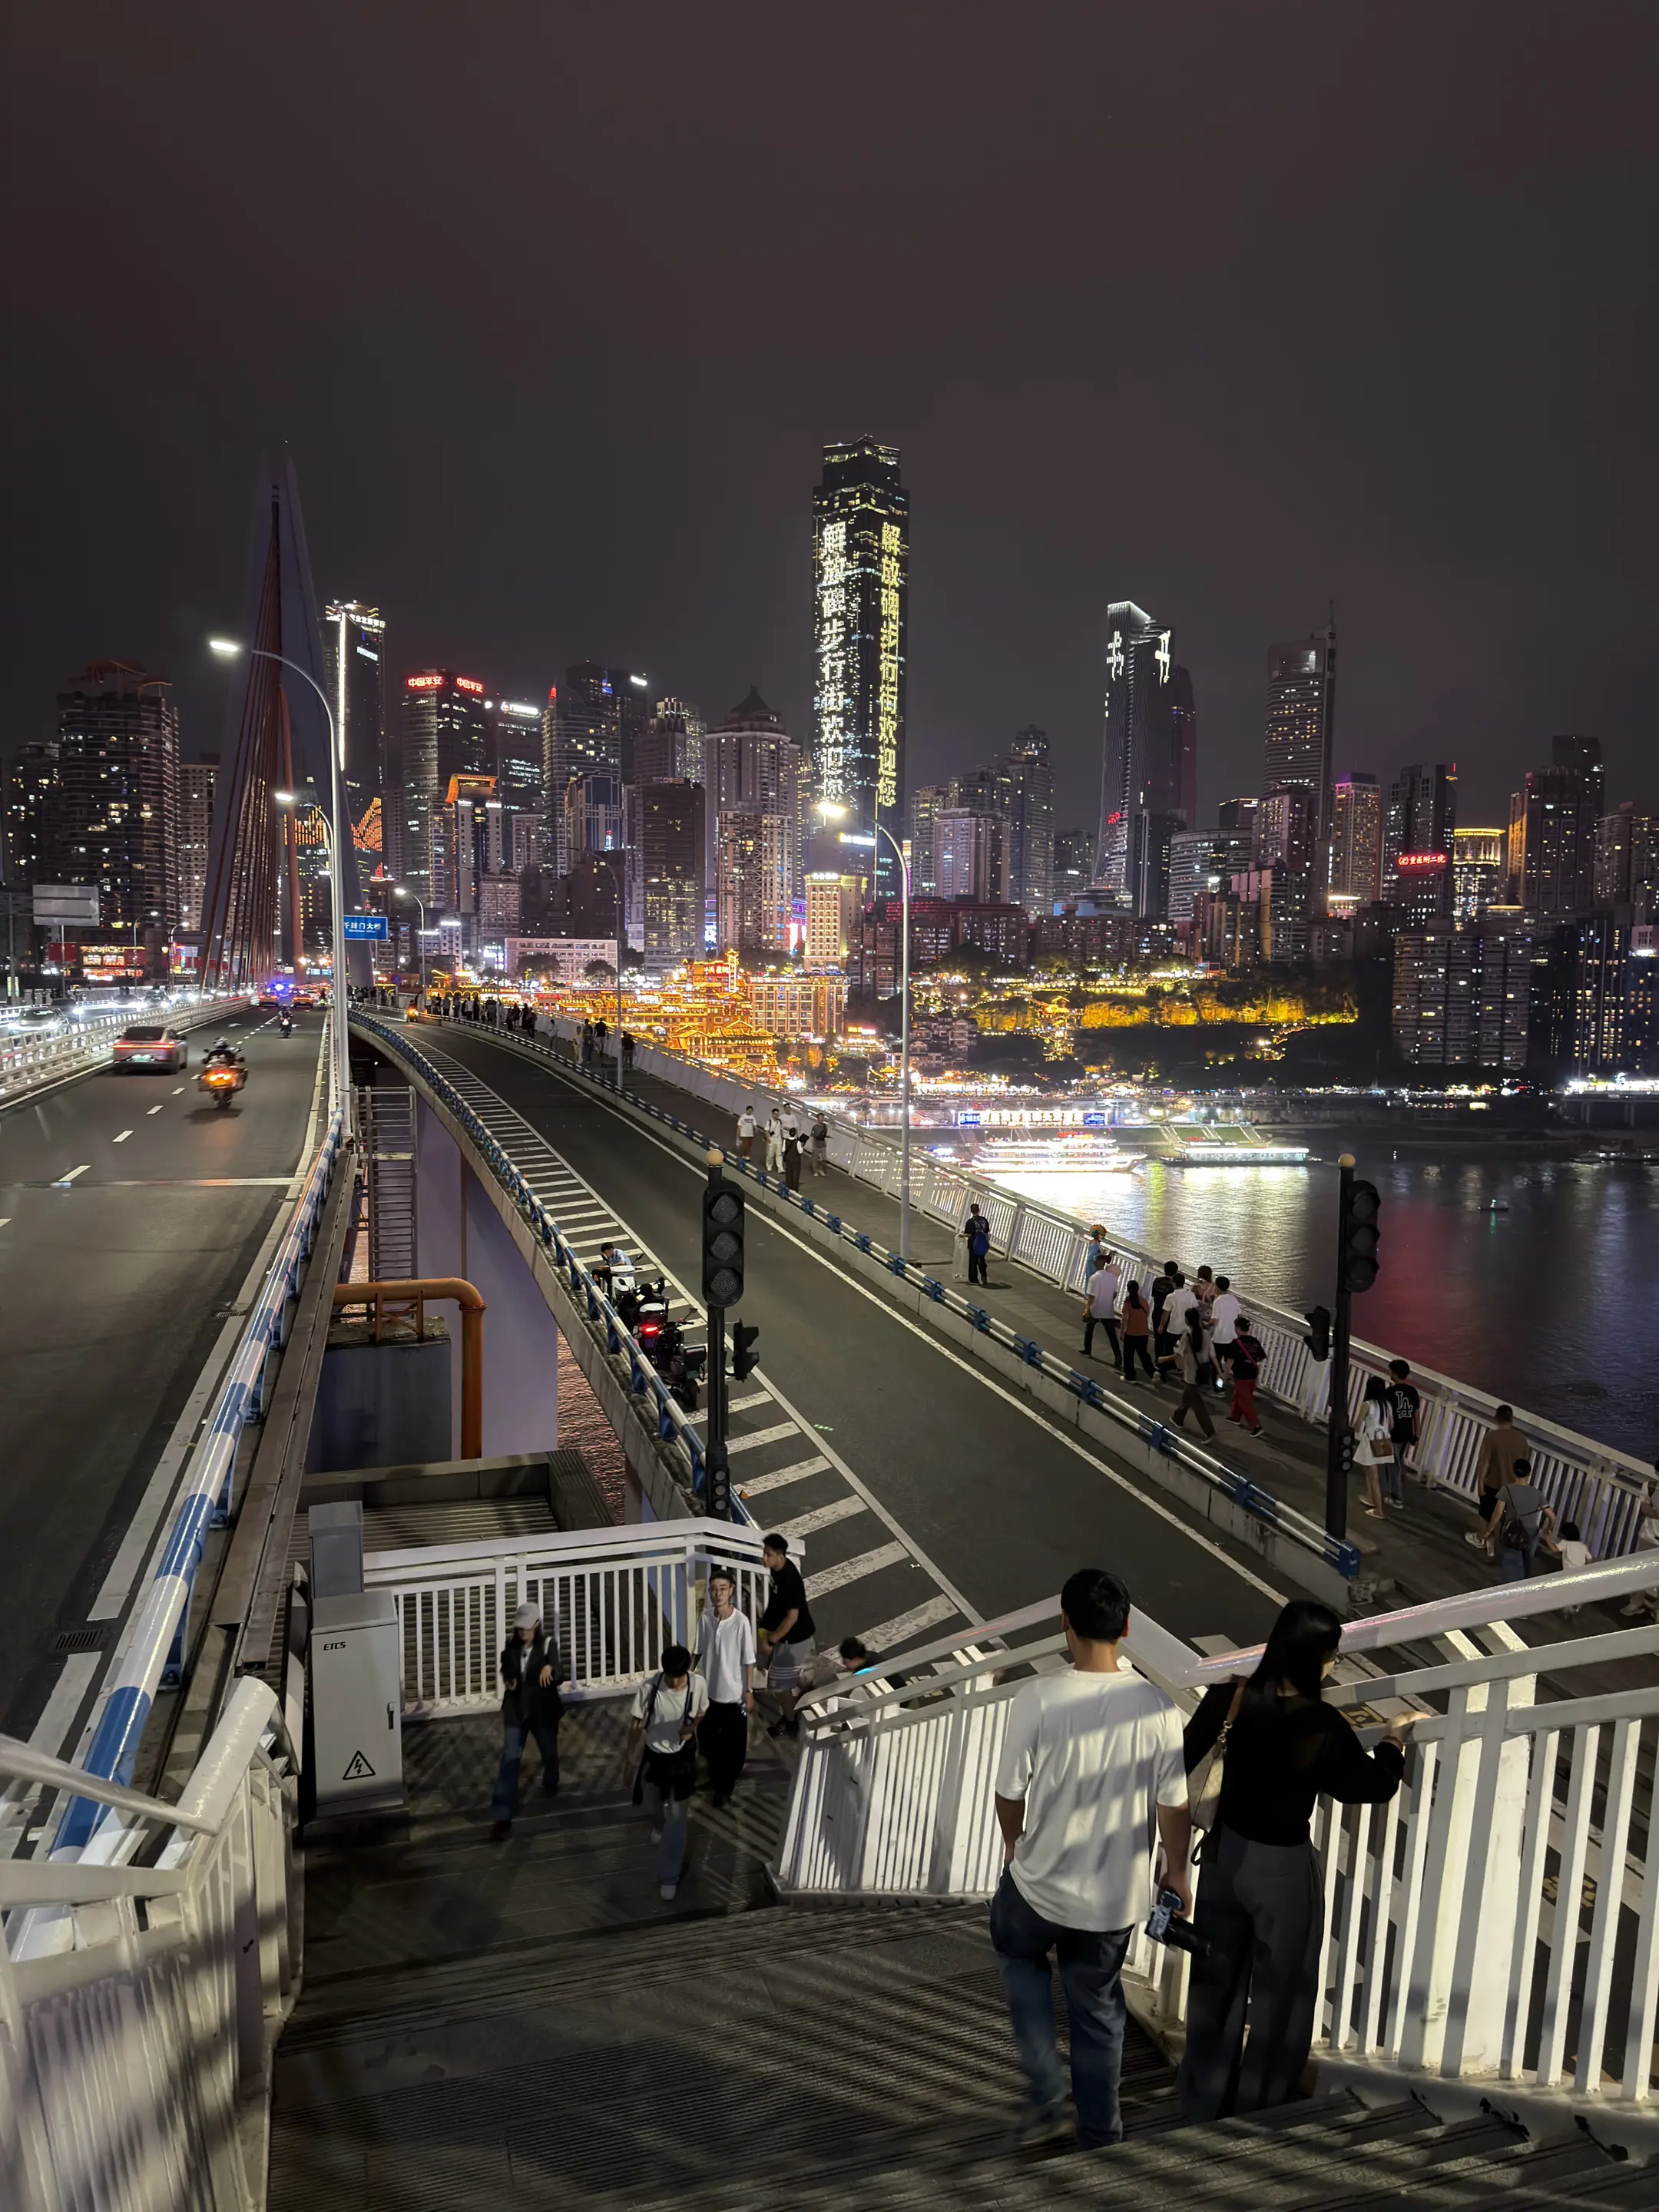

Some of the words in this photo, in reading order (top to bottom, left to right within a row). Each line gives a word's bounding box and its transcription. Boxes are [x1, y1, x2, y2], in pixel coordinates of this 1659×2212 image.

[879, 522, 902, 806] 解放碑步行街欢迎您
[408, 675, 443, 687] 中国平安
[456, 677, 484, 693] 中国平安
[1395, 1391, 1413, 1419] LA
[323, 1641, 346, 1651] ETCS
